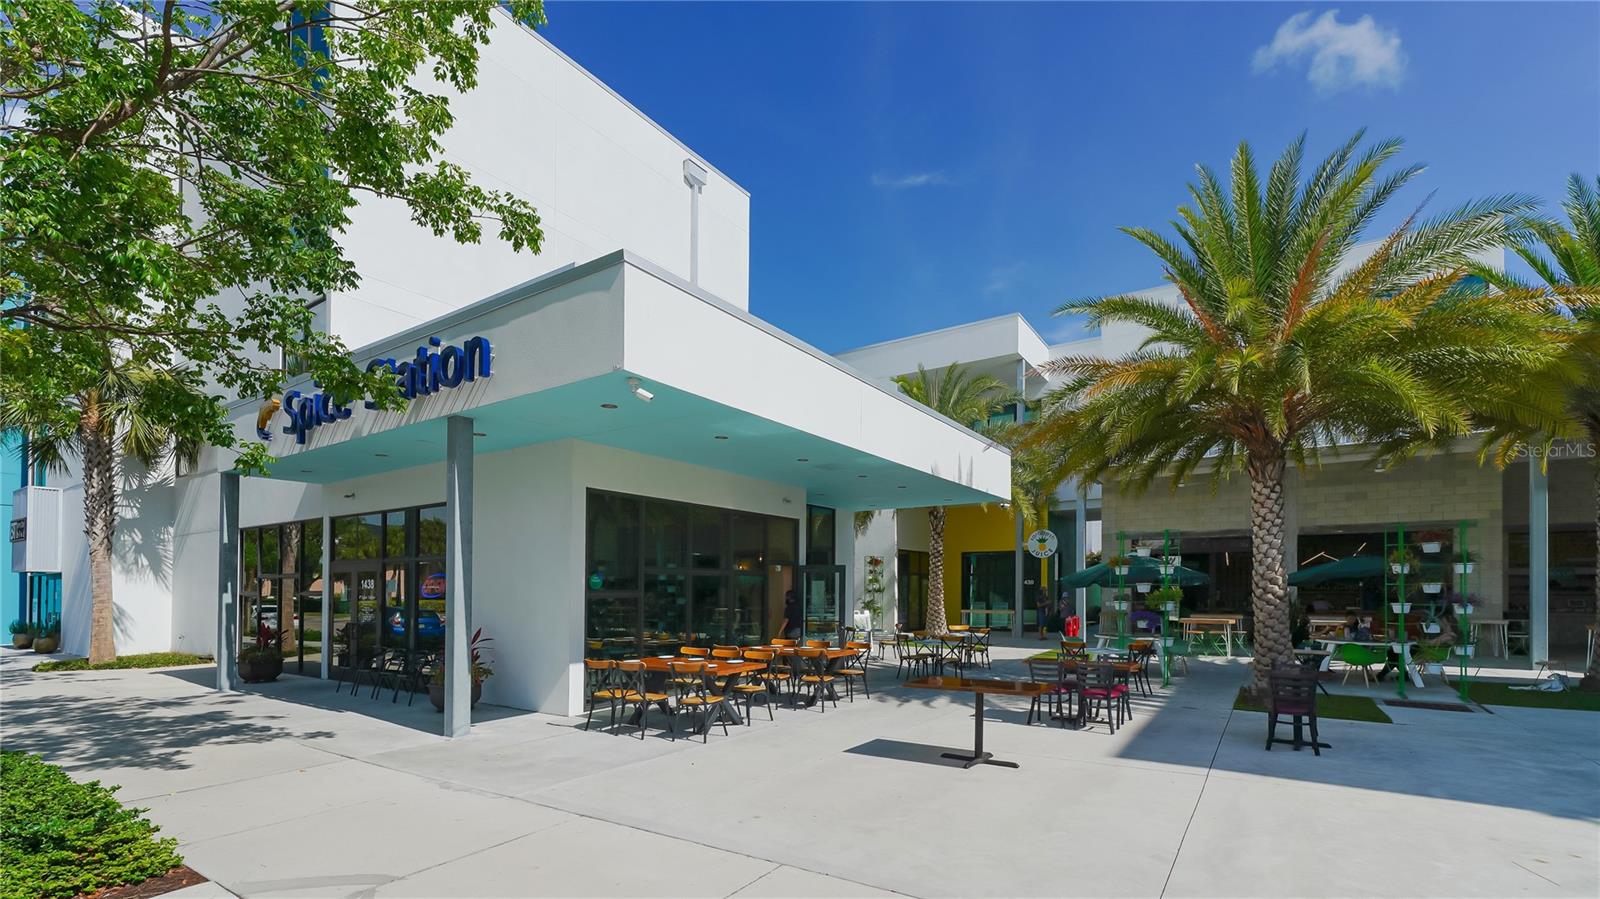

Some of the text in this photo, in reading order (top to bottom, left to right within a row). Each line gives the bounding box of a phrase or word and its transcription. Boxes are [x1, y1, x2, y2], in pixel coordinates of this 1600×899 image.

[364, 335, 491, 410] ation
[1031, 548, 1054, 557] JUICE
[361, 579, 375, 590] 1438
